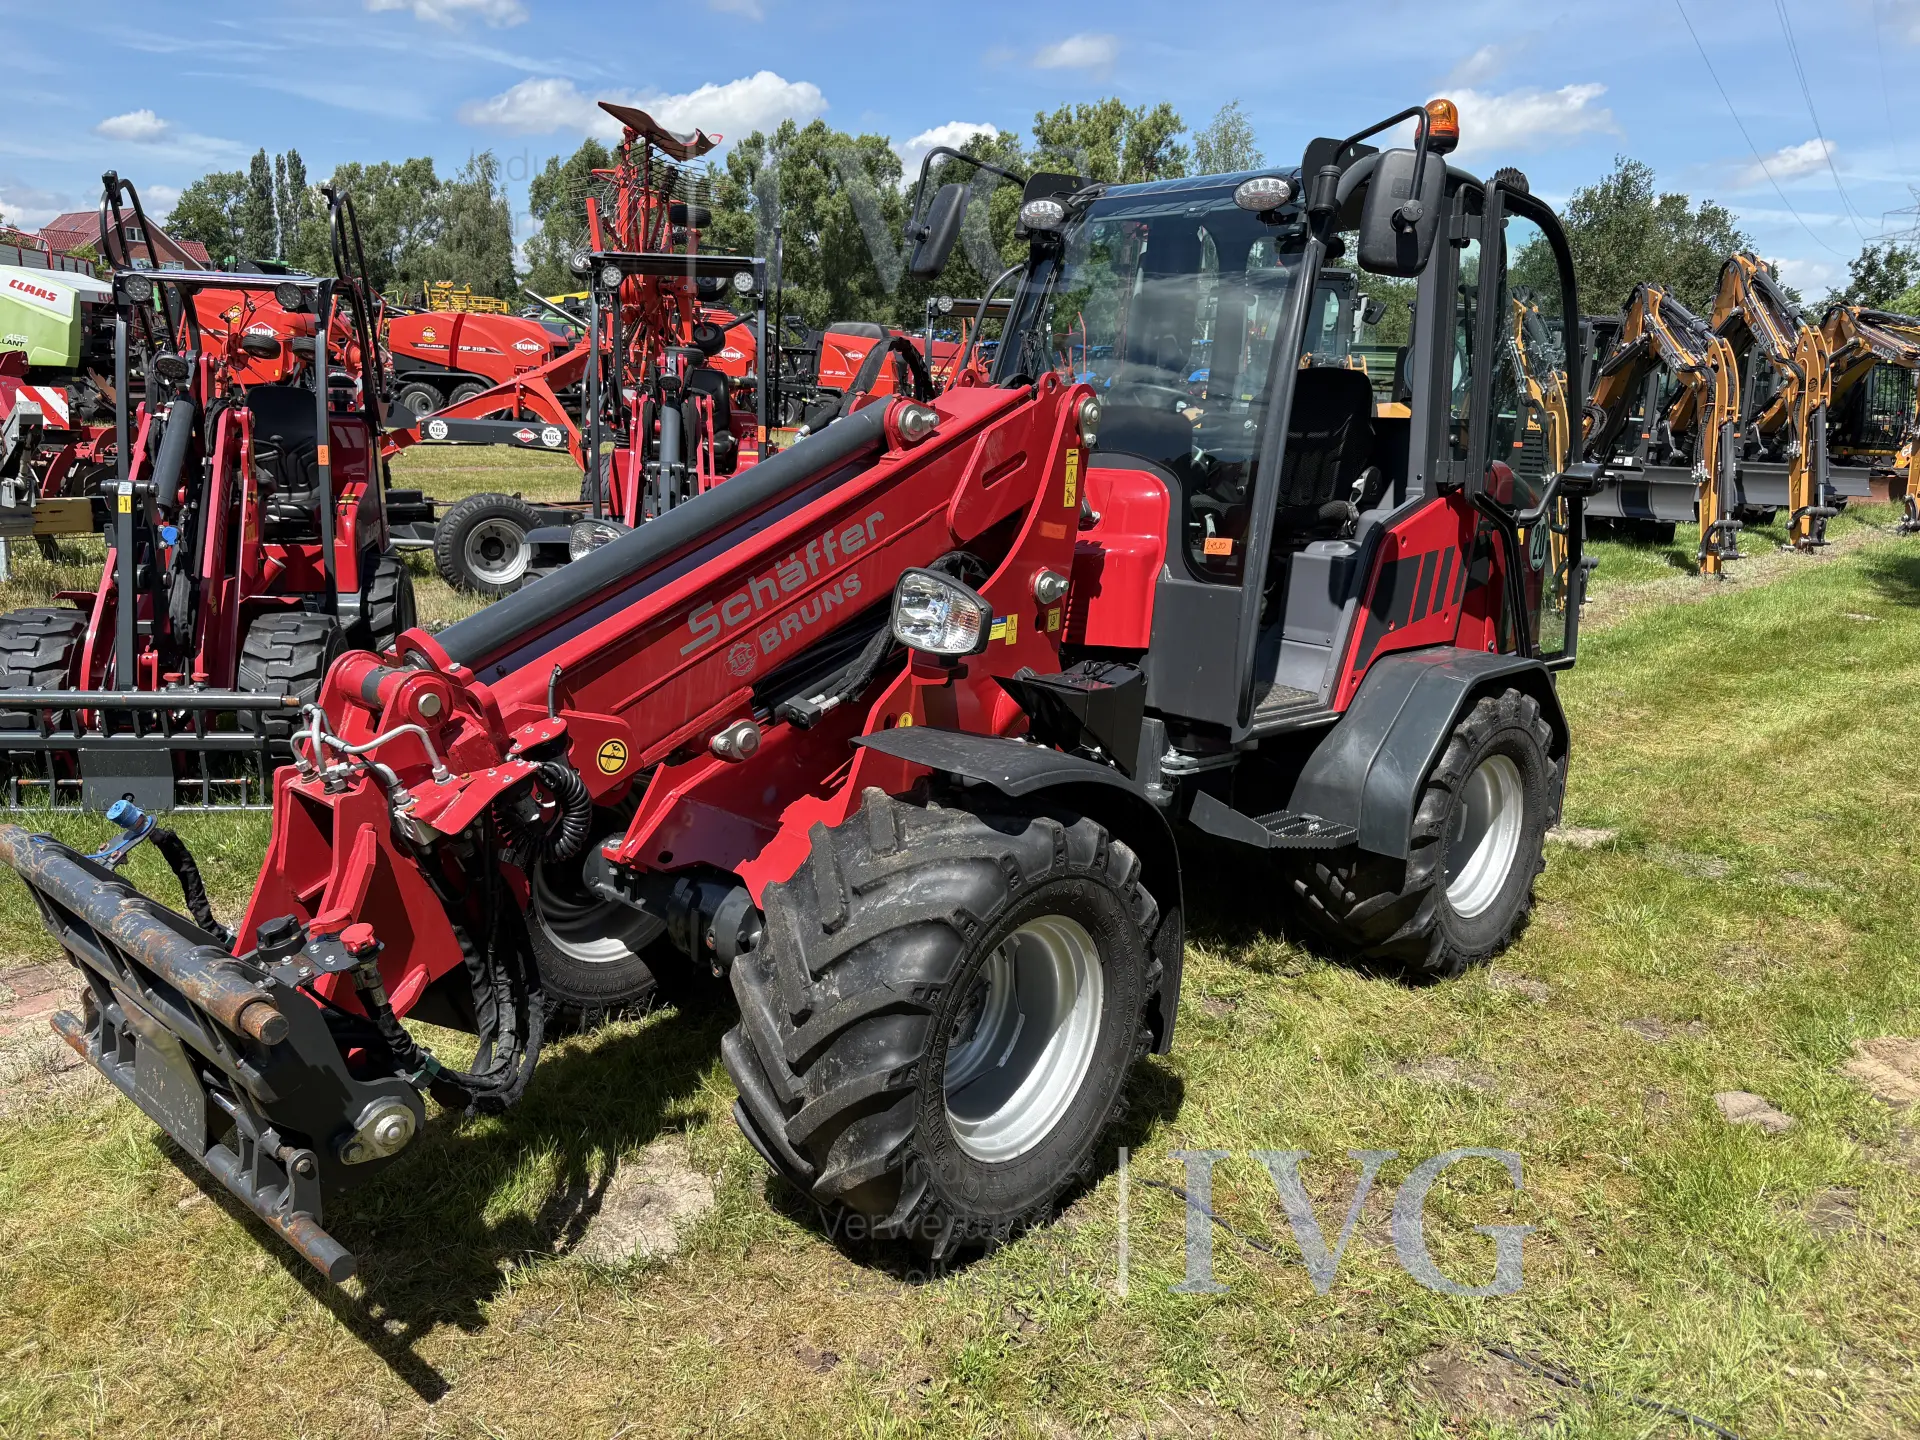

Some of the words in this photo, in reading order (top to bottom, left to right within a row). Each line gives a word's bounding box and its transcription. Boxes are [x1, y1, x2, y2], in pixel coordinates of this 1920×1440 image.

[9, 279, 58, 302] CLAAS
[249, 327, 274, 337] KUHN
[1751, 322, 1770, 352] CASE
[516, 342, 539, 351] KUHN
[1871, 344, 1898, 361] CASE
[721, 351, 742, 359] KUHN
[430, 426, 447, 435] ABC
[517, 431, 535, 439] KUHN
[544, 433, 561, 442] ABC
[1532, 523, 1547, 560] 20
[680, 511, 885, 656] Schäffer
[759, 573, 862, 655] BRUNS
